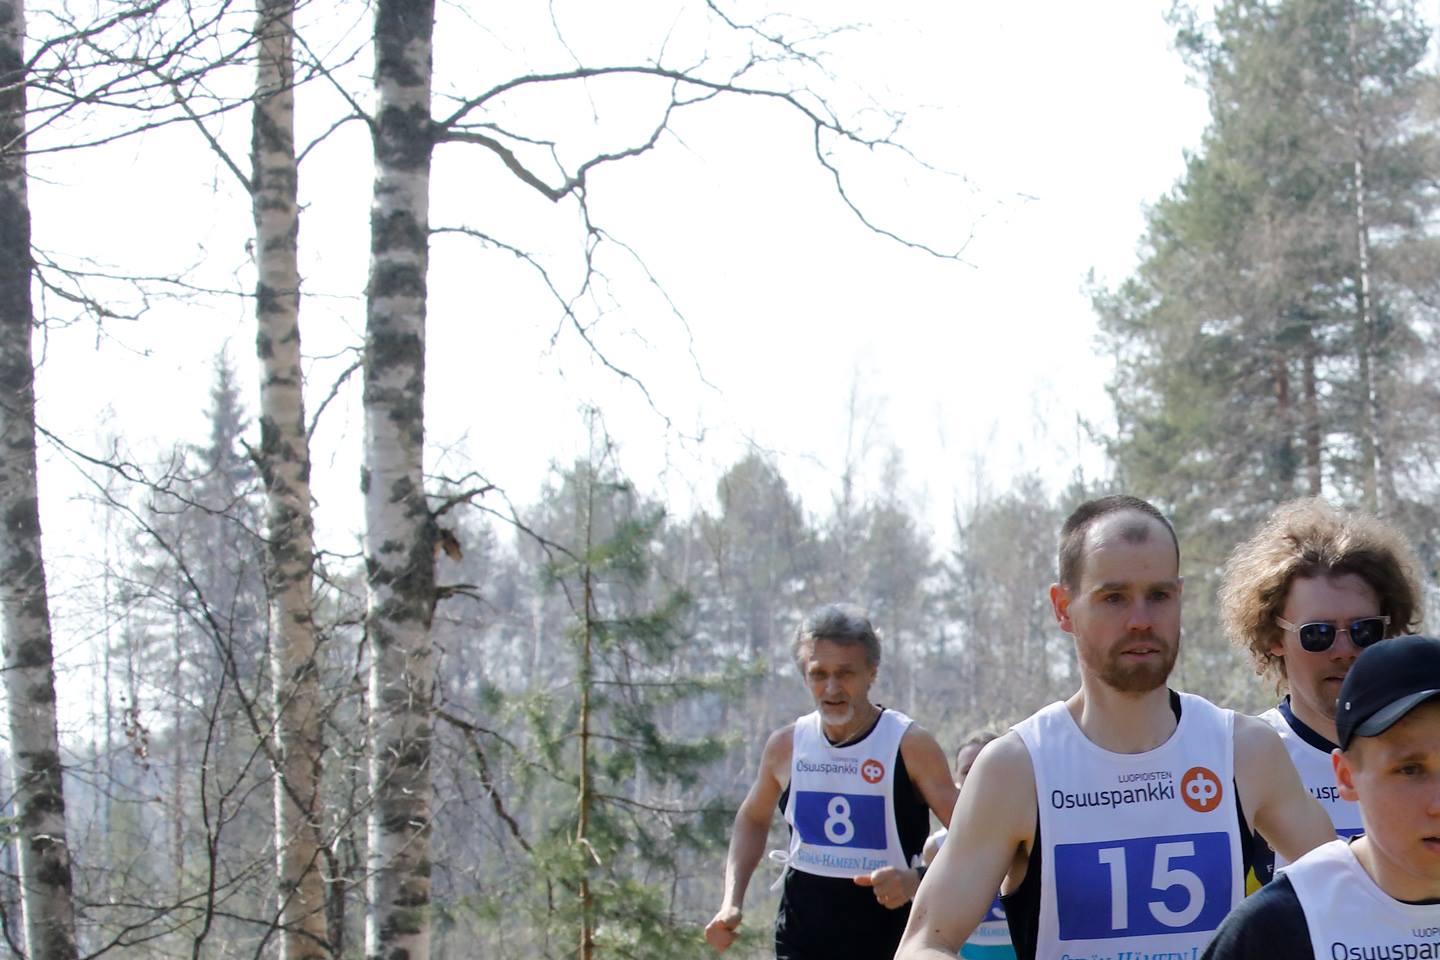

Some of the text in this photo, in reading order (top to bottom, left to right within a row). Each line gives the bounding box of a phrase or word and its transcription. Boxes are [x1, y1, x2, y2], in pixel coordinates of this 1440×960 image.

[796, 760, 858, 776] Osuuspankki
[1051, 780, 1175, 809] Osuuspankki
[824, 795, 855, 845] 8
[1098, 840, 1206, 931] 15
